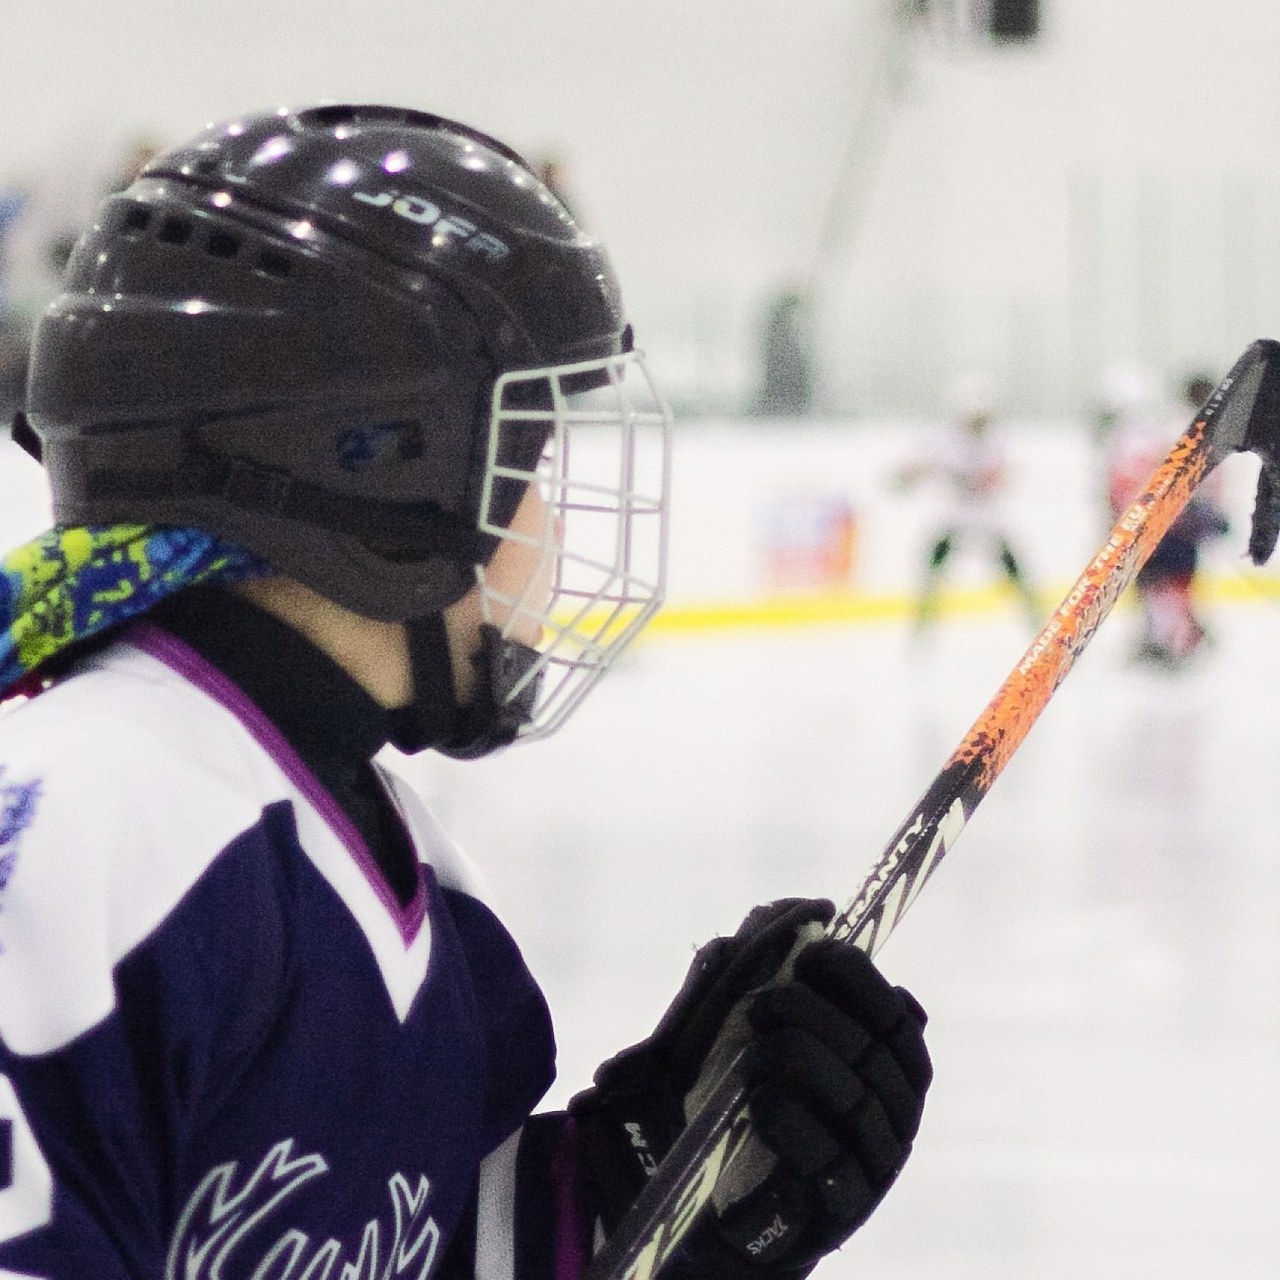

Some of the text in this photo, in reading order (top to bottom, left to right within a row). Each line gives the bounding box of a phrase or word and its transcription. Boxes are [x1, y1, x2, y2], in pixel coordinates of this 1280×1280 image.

[1019, 620, 1065, 676] MADE
[1060, 577, 1092, 617] FOR
[745, 1213, 789, 1256] TACKS
